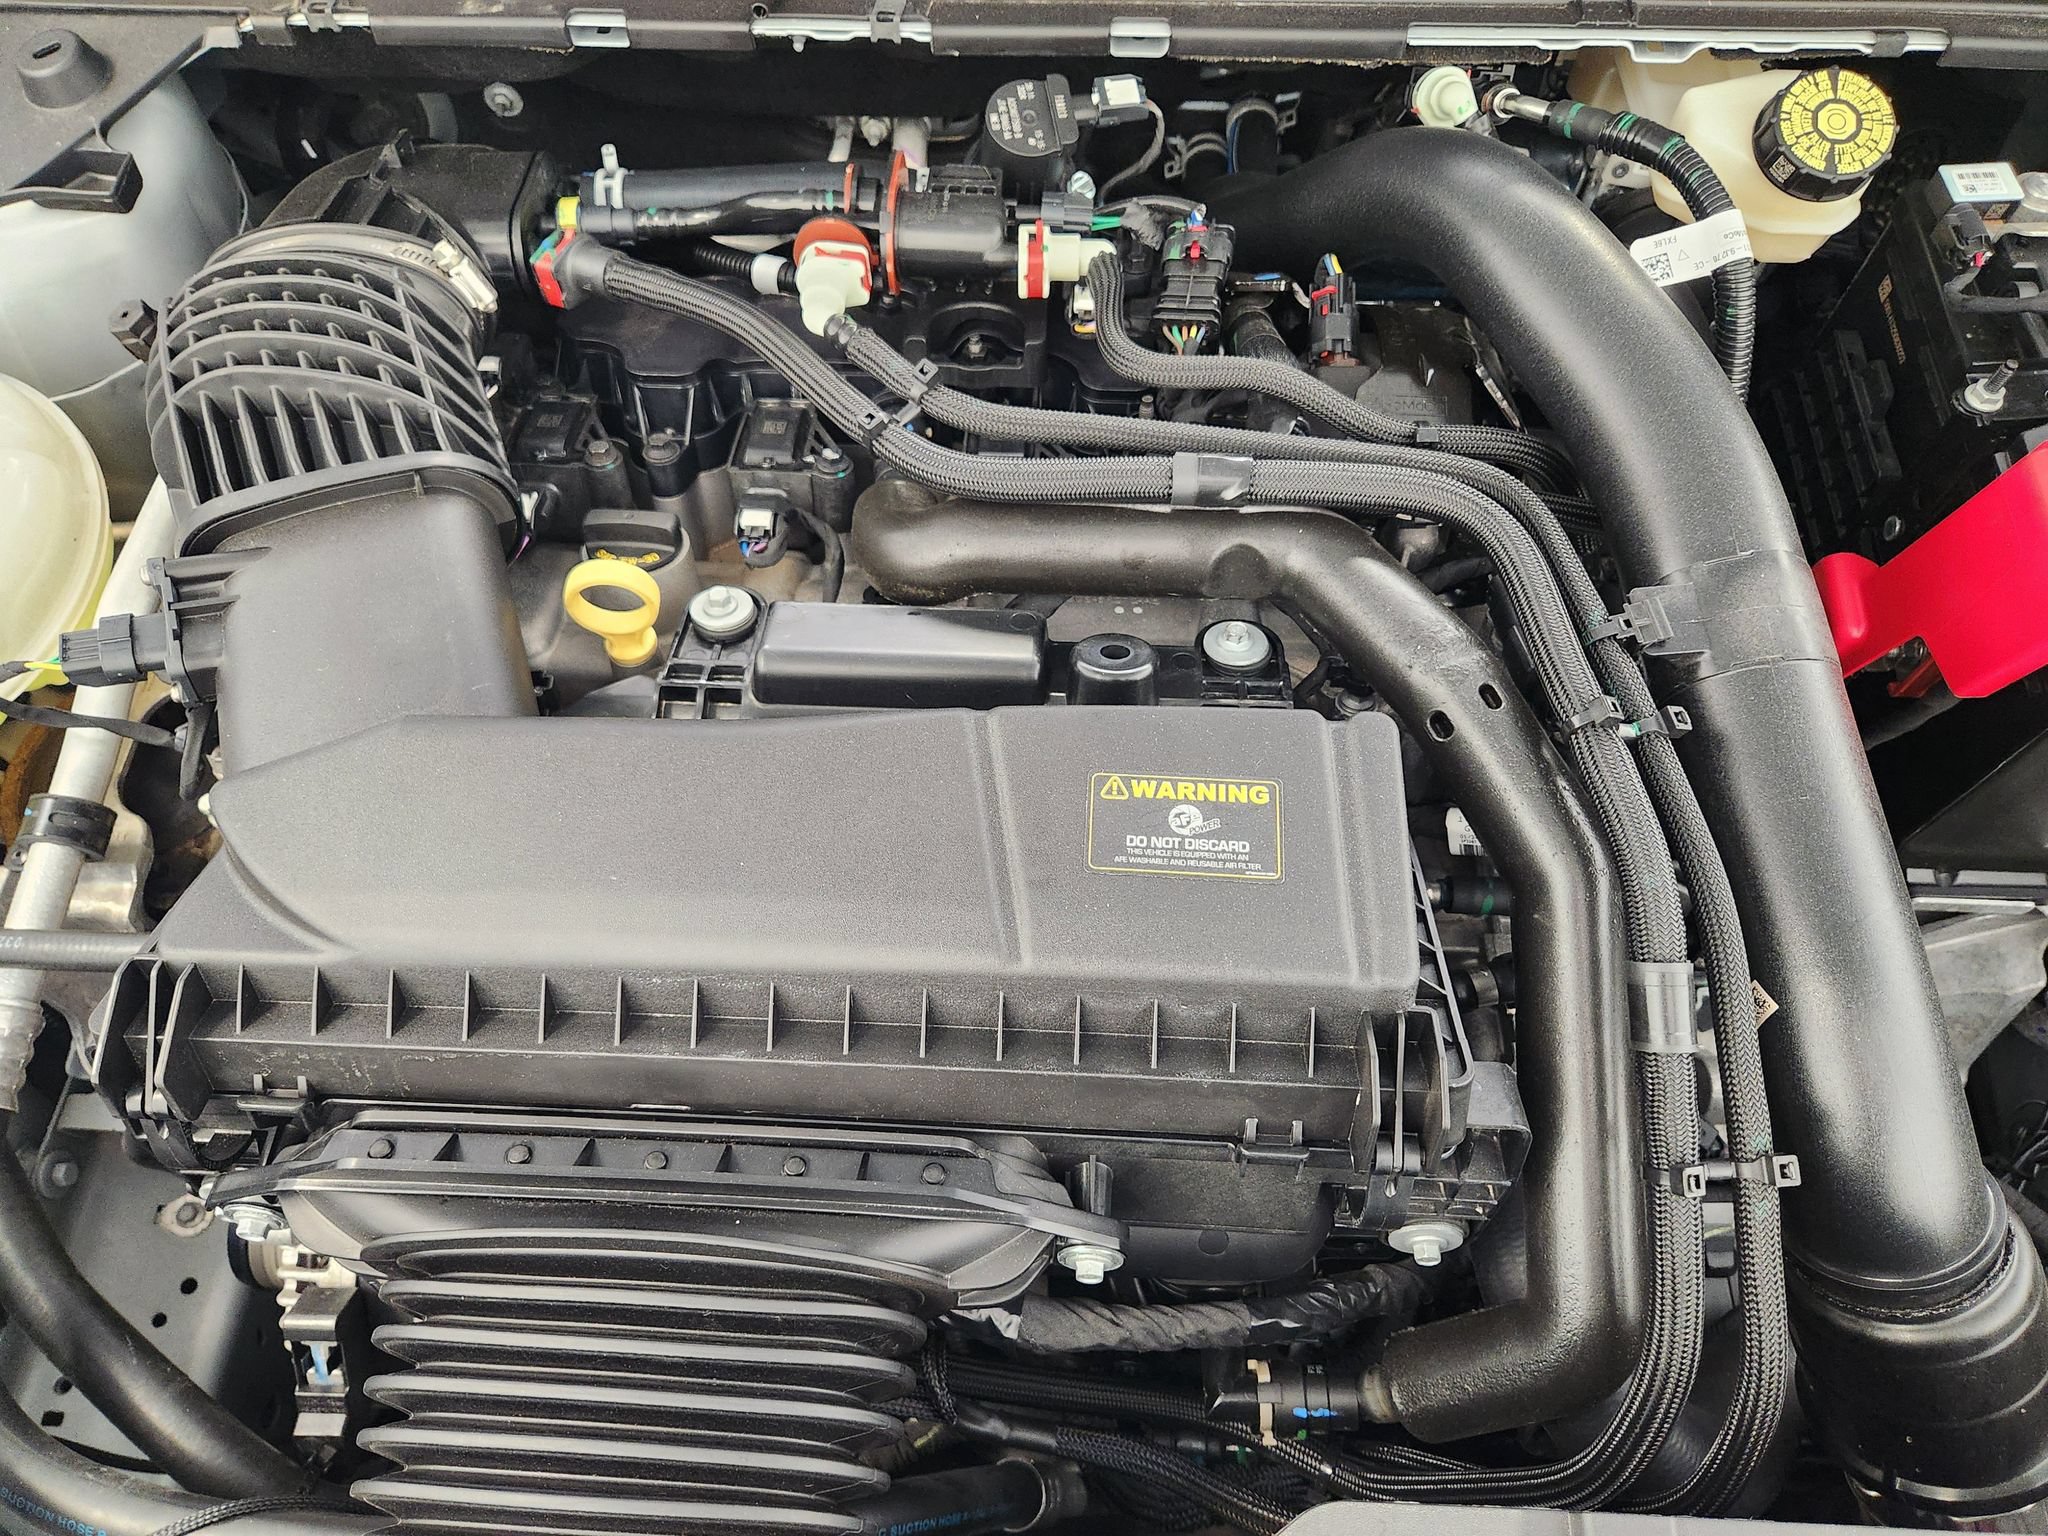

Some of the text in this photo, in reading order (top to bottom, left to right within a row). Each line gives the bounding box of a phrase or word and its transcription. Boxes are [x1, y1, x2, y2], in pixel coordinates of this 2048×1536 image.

[1130, 779, 1270, 805] WARNING
[1189, 819, 1219, 833] POWER
[1126, 834, 1250, 852] DO NOT DISCARD
[1126, 847, 1143, 855] THIS
[1143, 848, 1172, 857] VEHICLE
[1180, 850, 1216, 859] EQUIPPED
[1216, 852, 1237, 861] WITH
[1128, 856, 1169, 865] WASHABLE
[1169, 858, 1187, 866] AND
[1187, 859, 1224, 869] REUSABLE
[0, 1486, 55, 1521] SUCTION
[57, 1515, 94, 1536] HOSE
